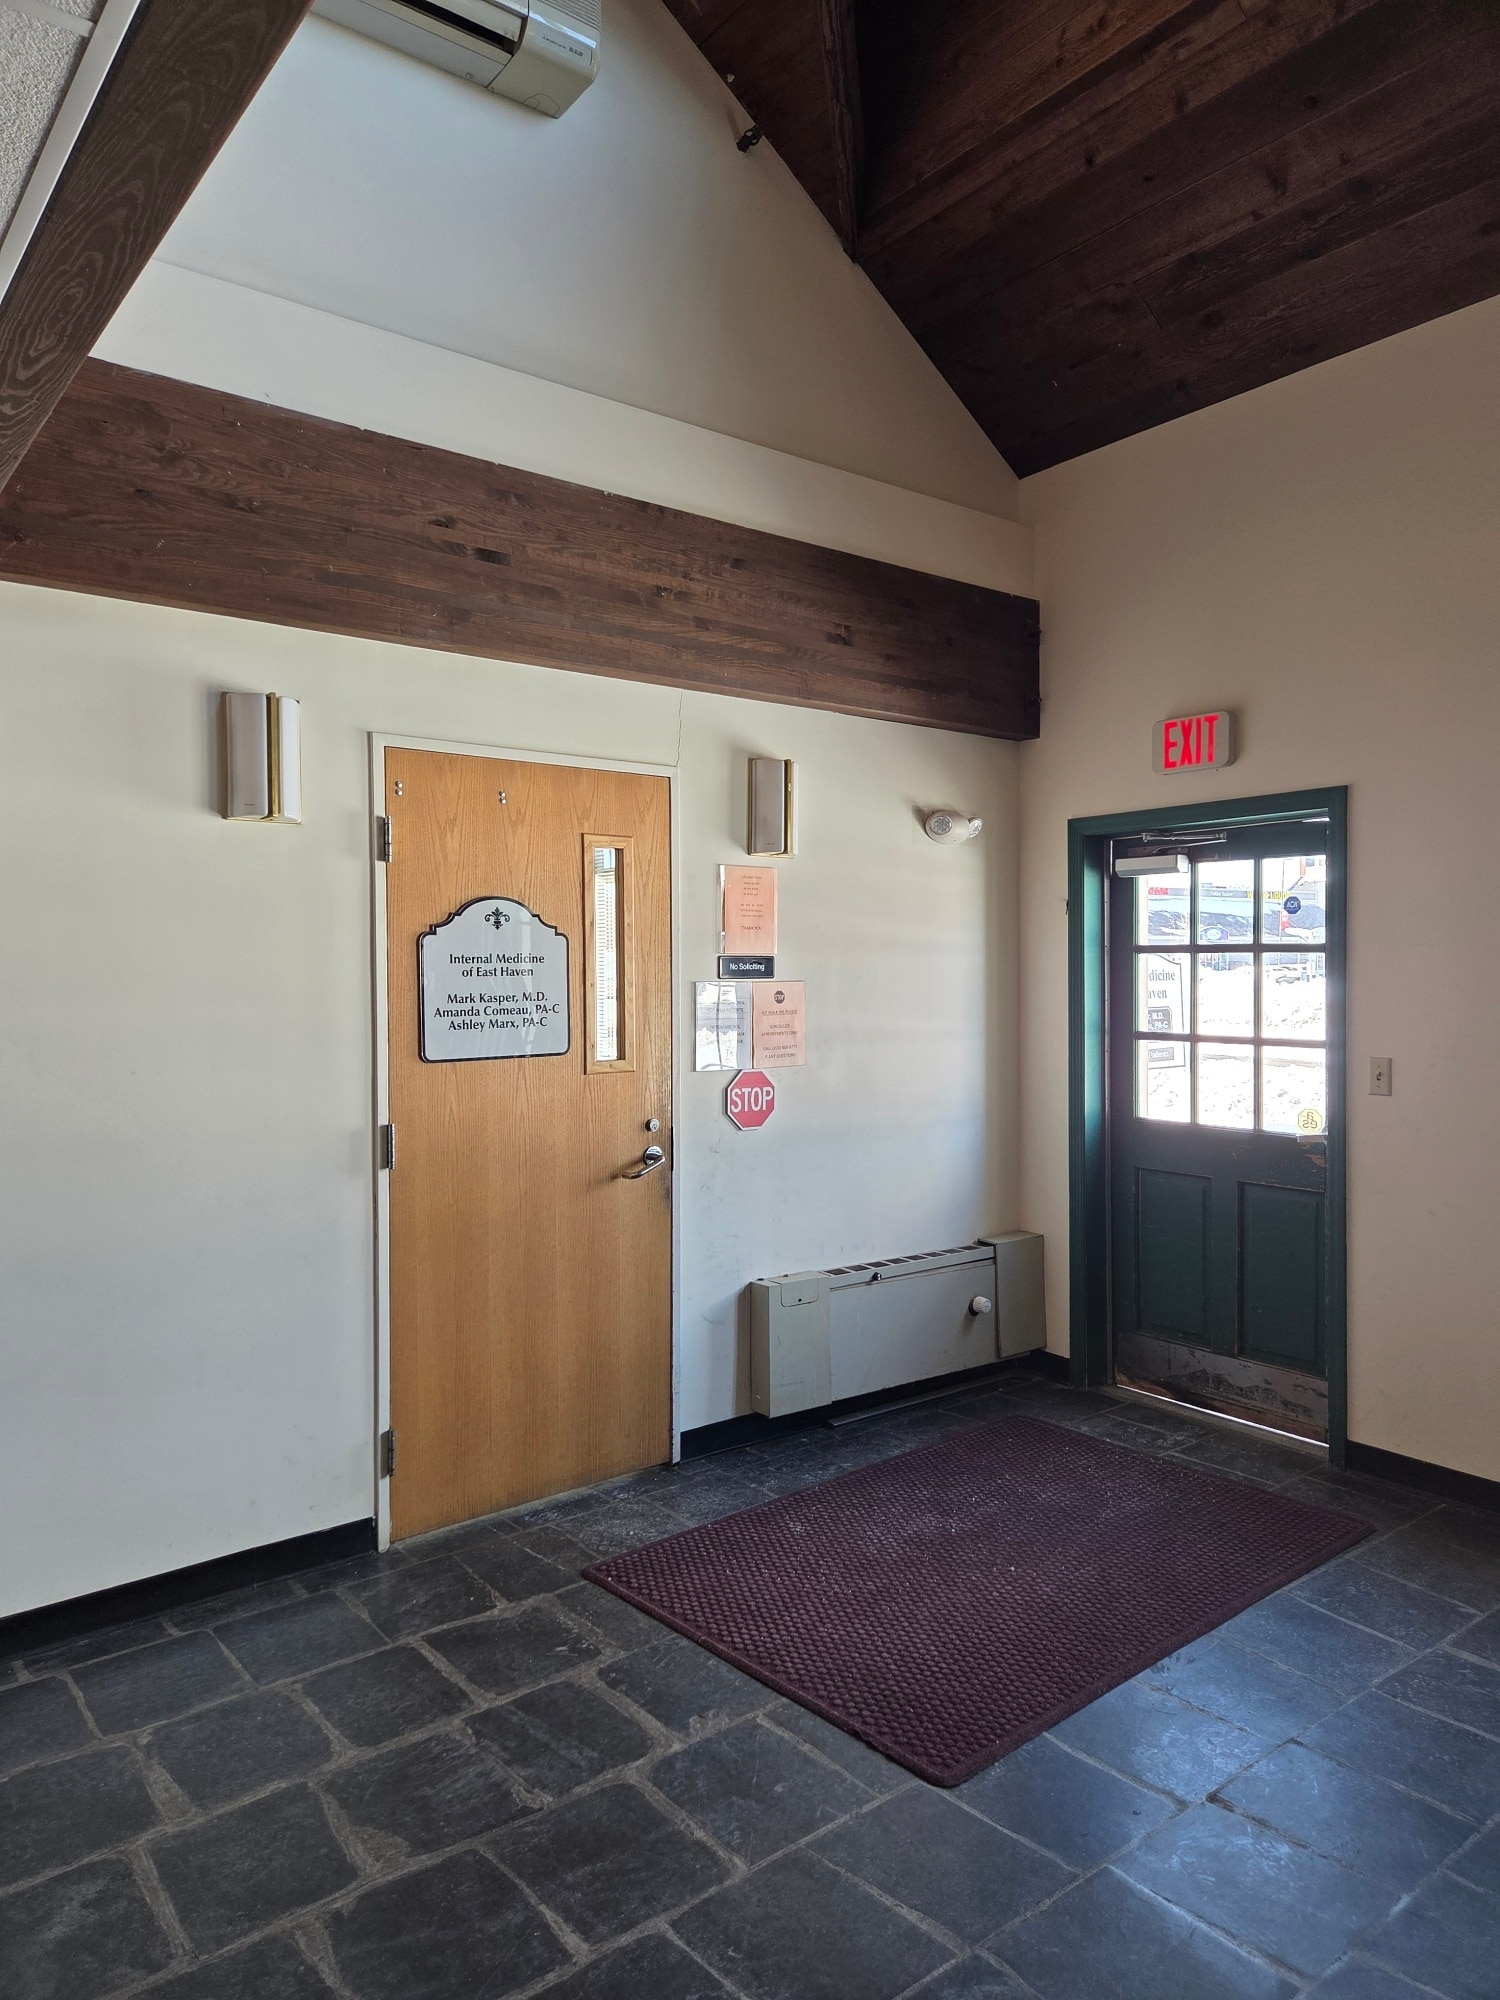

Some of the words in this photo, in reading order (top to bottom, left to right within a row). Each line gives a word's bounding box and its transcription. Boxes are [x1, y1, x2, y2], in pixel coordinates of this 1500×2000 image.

[1163, 714, 1219, 769] EXIT
[449, 953, 492, 964] Internal
[495, 953, 545, 964] Medicine
[461, 966, 474, 977] of
[476, 966, 498, 977] East
[500, 966, 534, 977] Haven
[739, 963, 765, 972] Soliciting
[1149, 969, 1176, 981] dicine
[446, 993, 476, 1004] Mark
[479, 992, 519, 1006] Kasper,
[521, 991, 548, 1002] M.D.
[1148, 989, 1167, 999] aven
[433, 1006, 480, 1018] Amanda
[483, 1005, 532, 1016] Comeau,
[535, 1003, 560, 1014] PA-C
[448, 1018, 486, 1032] Ashley
[488, 1018, 519, 1029] Marx,
[522, 1016, 548, 1028] PA-C
[730, 1086, 774, 1113] STOP
